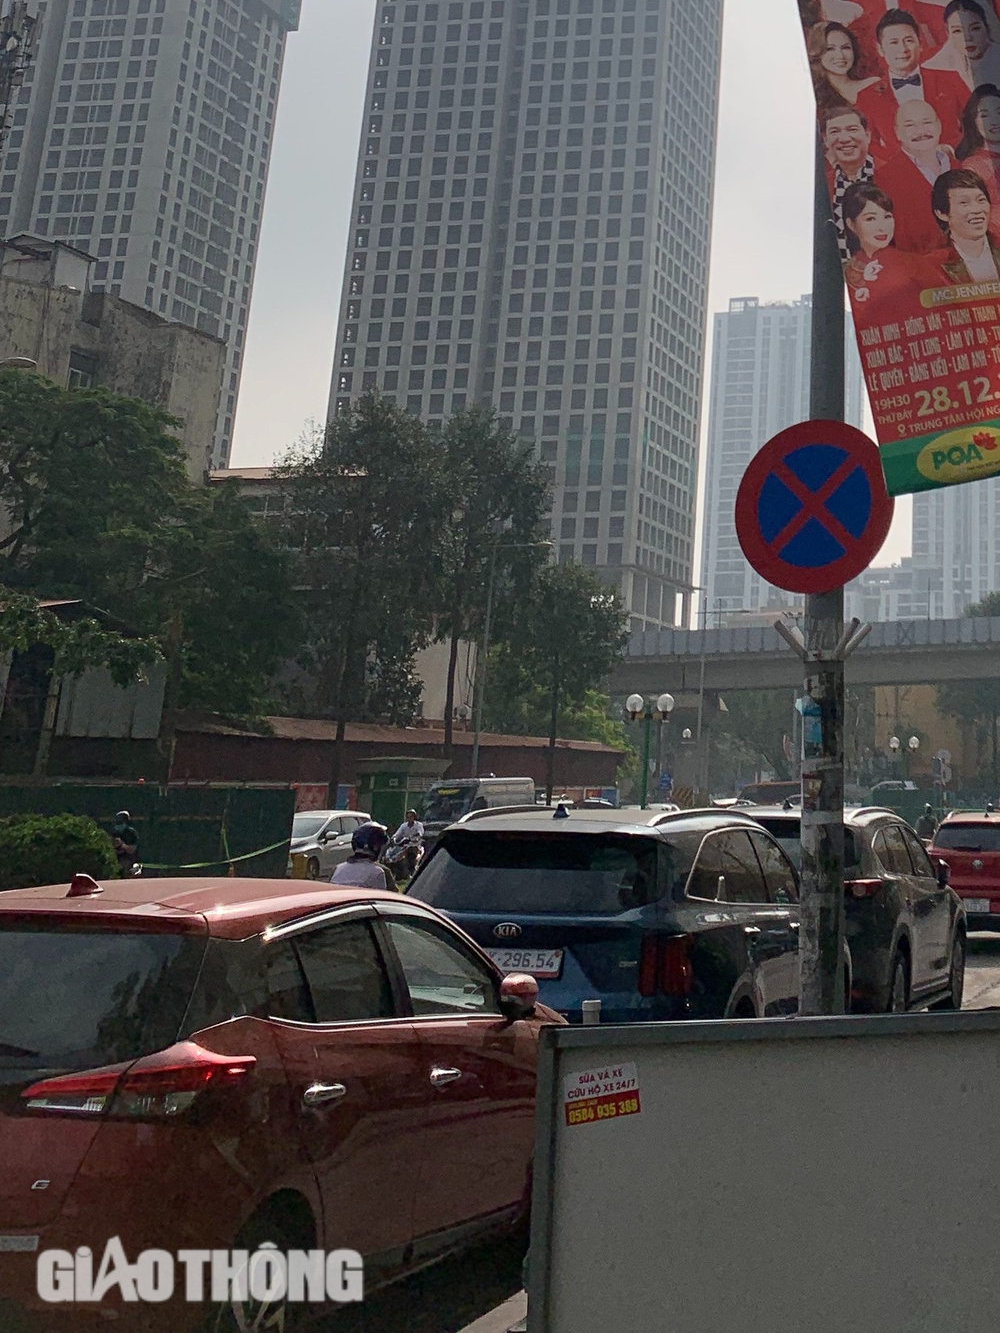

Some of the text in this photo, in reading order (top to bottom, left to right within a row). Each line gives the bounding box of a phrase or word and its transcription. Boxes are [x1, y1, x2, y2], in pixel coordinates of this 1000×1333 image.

[874, 393, 911, 410] 19H30
[908, 417, 943, 433] TRUNG
[499, 925, 517, 937] KIA
[612, 1068, 623, 1079] XE
[603, 1082, 614, 1093] XE
[616, 1078, 636, 1091] 24/7
